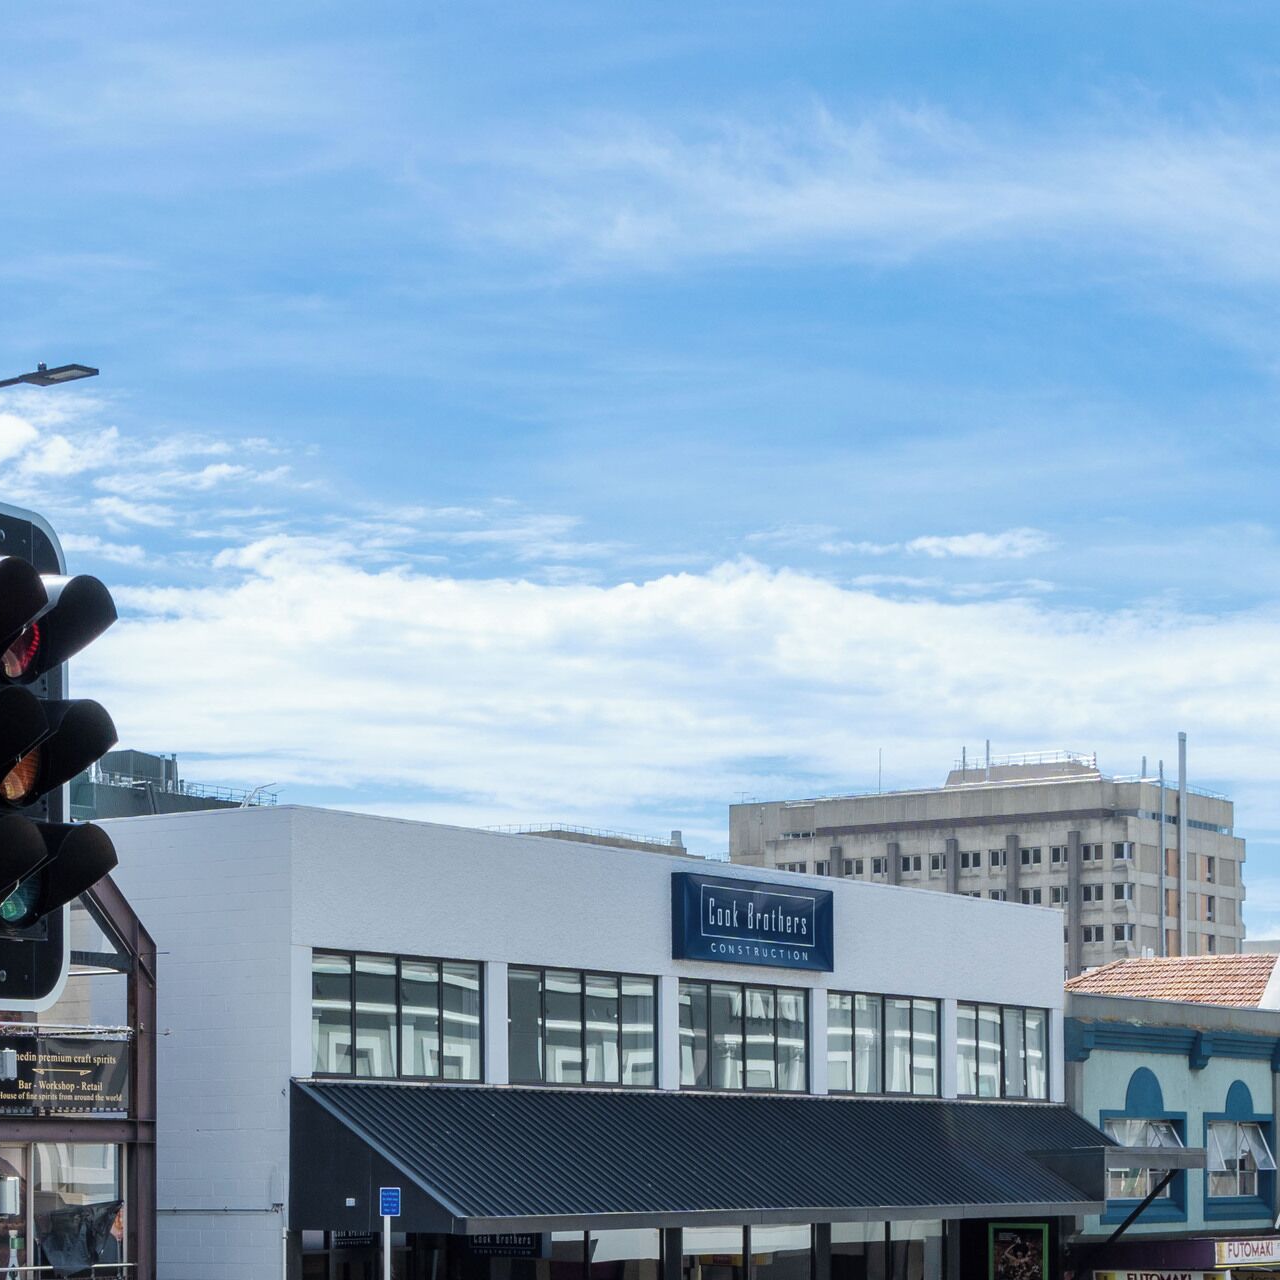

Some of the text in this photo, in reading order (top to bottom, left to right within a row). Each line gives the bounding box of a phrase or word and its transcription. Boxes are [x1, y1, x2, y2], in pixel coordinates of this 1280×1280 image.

[708, 897, 807, 935] Cook Brothers
[710, 942, 808, 961] CONSTRUCTION
[16, 1052, 117, 1066] nedin premium craft spirits
[18, 1080, 32, 1090] Bar
[39, 1080, 75, 1092] Workshop
[81, 1081, 103, 1091] Retail
[18, 1091, 25, 1100] of
[26, 1092, 37, 1101] fine
[38, 1092, 58, 1102] spirits
[58, 1092, 73, 1101] from
[73, 1092, 94, 1102] around
[95, 1092, 104, 1102] the
[105, 1094, 122, 1102] world
[1228, 1241, 1274, 1258] FUTOMAKI
